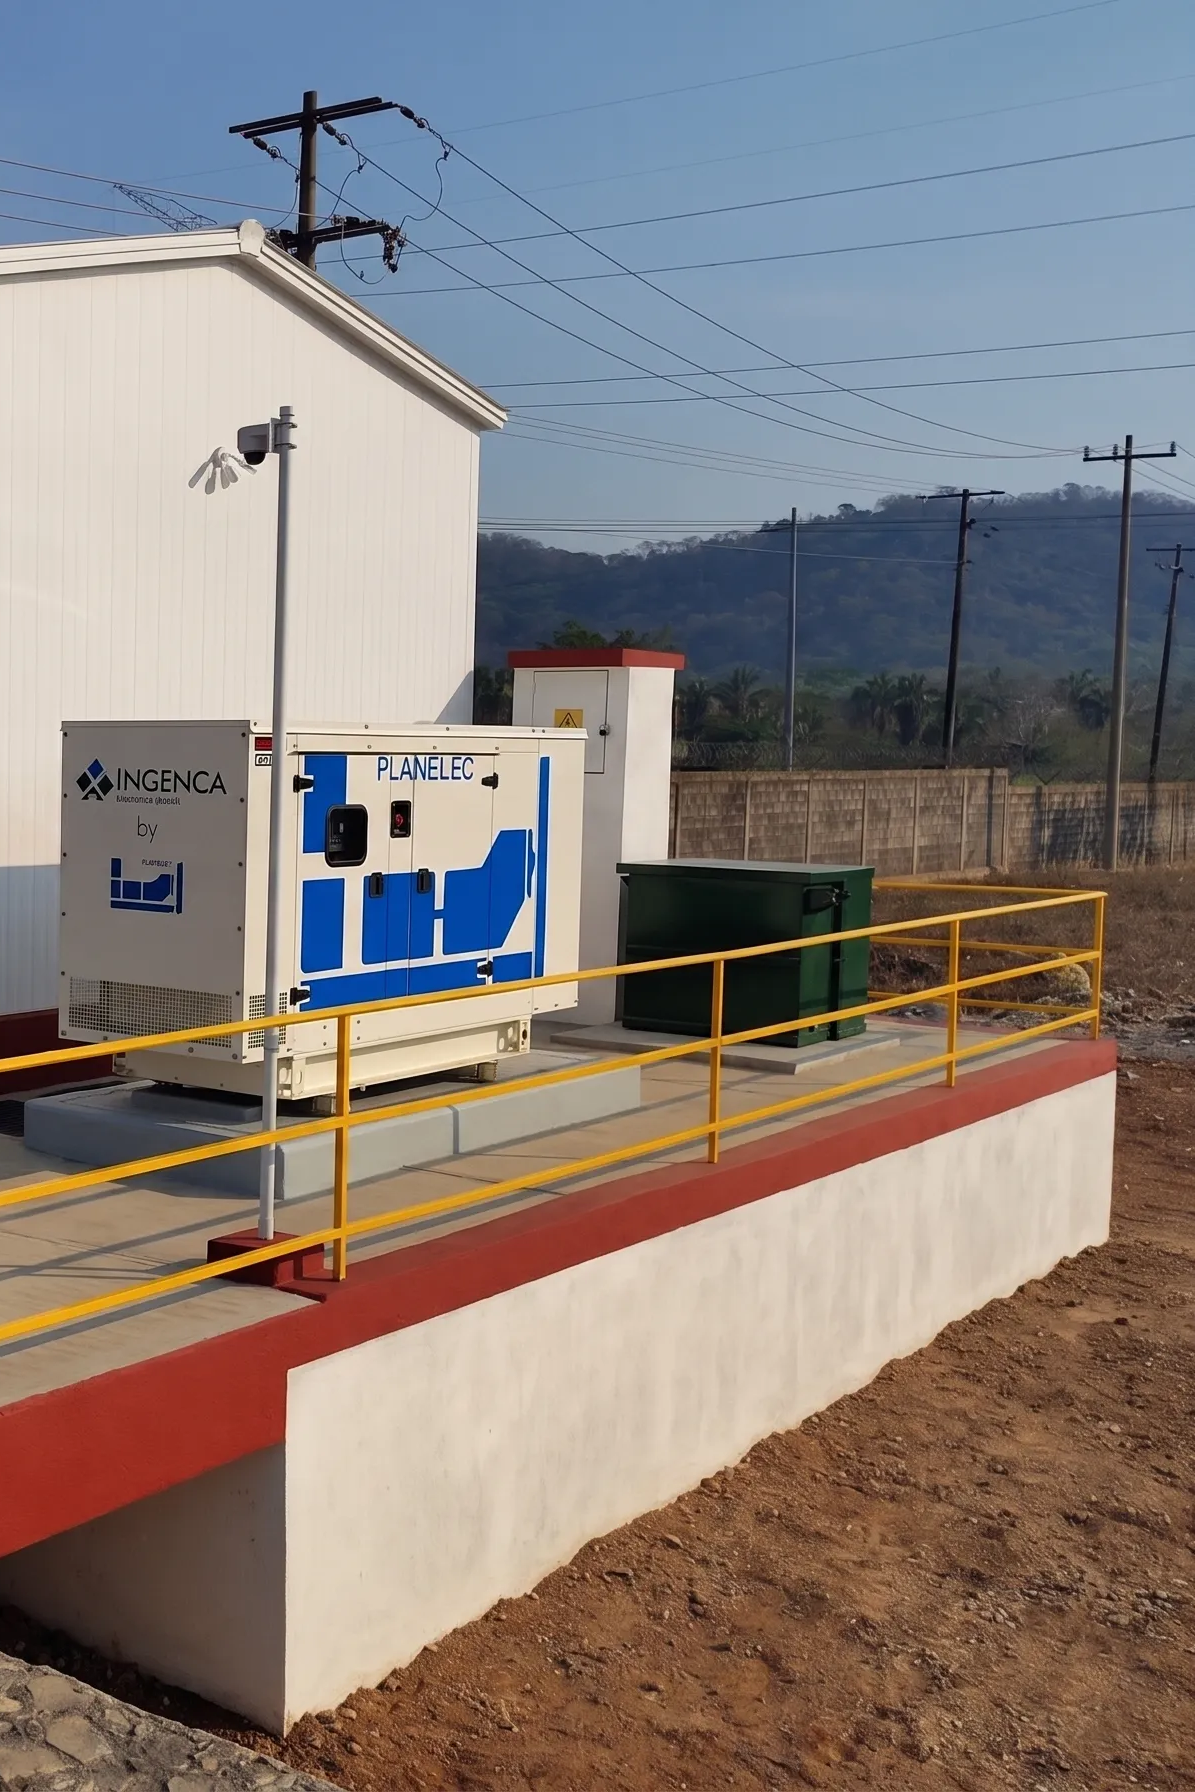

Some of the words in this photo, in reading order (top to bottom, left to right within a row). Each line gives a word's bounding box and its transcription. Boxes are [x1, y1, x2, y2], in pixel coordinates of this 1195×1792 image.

[116, 767, 227, 795] INGENCA
[377, 756, 474, 781] PLANELEC
[137, 814, 158, 844] by
